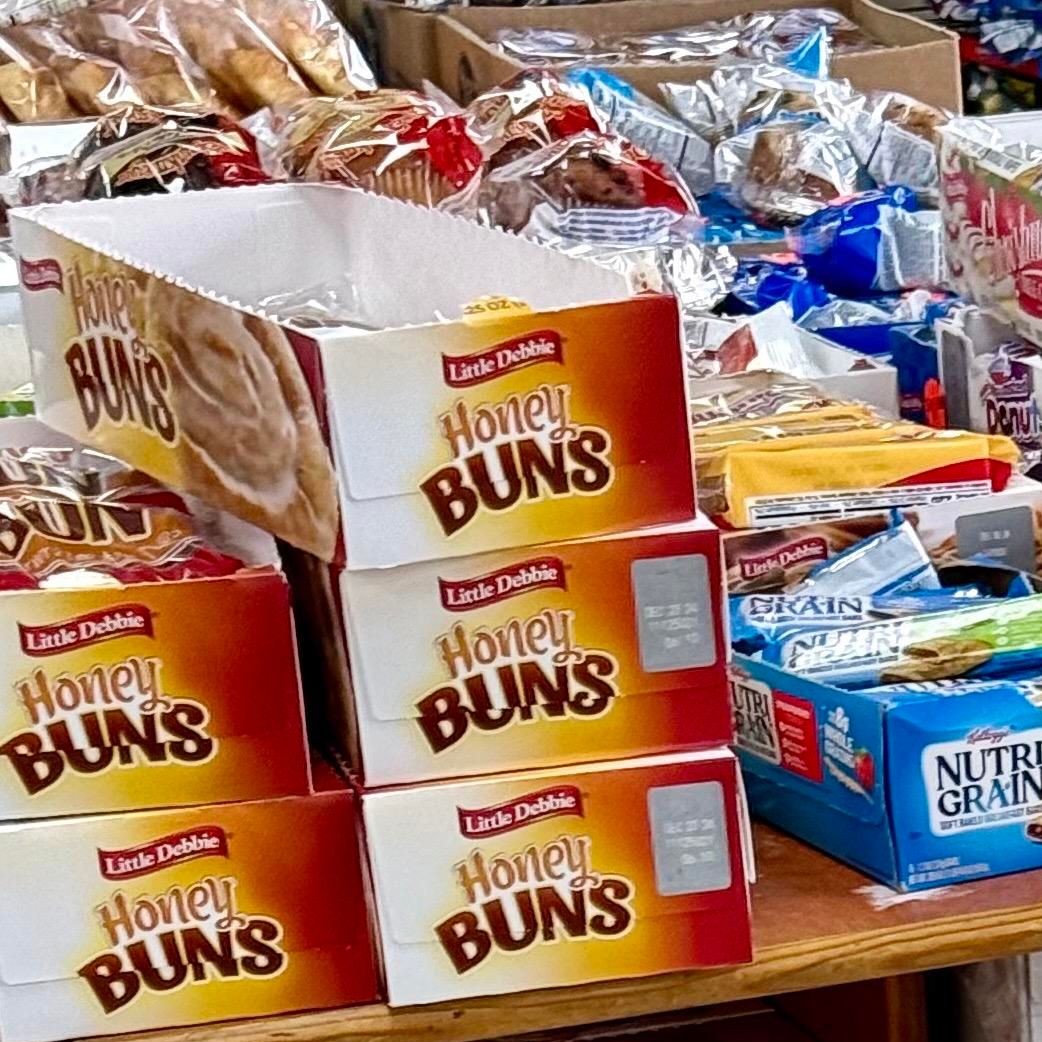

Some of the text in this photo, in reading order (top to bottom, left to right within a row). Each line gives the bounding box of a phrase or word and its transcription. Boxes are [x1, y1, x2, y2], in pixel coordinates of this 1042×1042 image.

[64, 333, 179, 444] BUNS
[450, 338, 556, 382] Little Debbie
[440, 385, 578, 459] Honey
[419, 430, 611, 537] BUNS
[445, 563, 559, 606] Little Debbie
[26, 611, 146, 651] Little Debbie
[436, 609, 584, 680] Honey
[16, 656, 173, 725] Honey
[415, 653, 615, 753] BUNS
[0, 702, 214, 796] BUNS
[464, 792, 577, 833] Little Debbie
[105, 835, 221, 876] Little Debbie
[456, 836, 600, 903] Honey
[98, 876, 247, 947] Honey
[433, 878, 632, 975] BUNS
[77, 918, 284, 1016] BUNS
